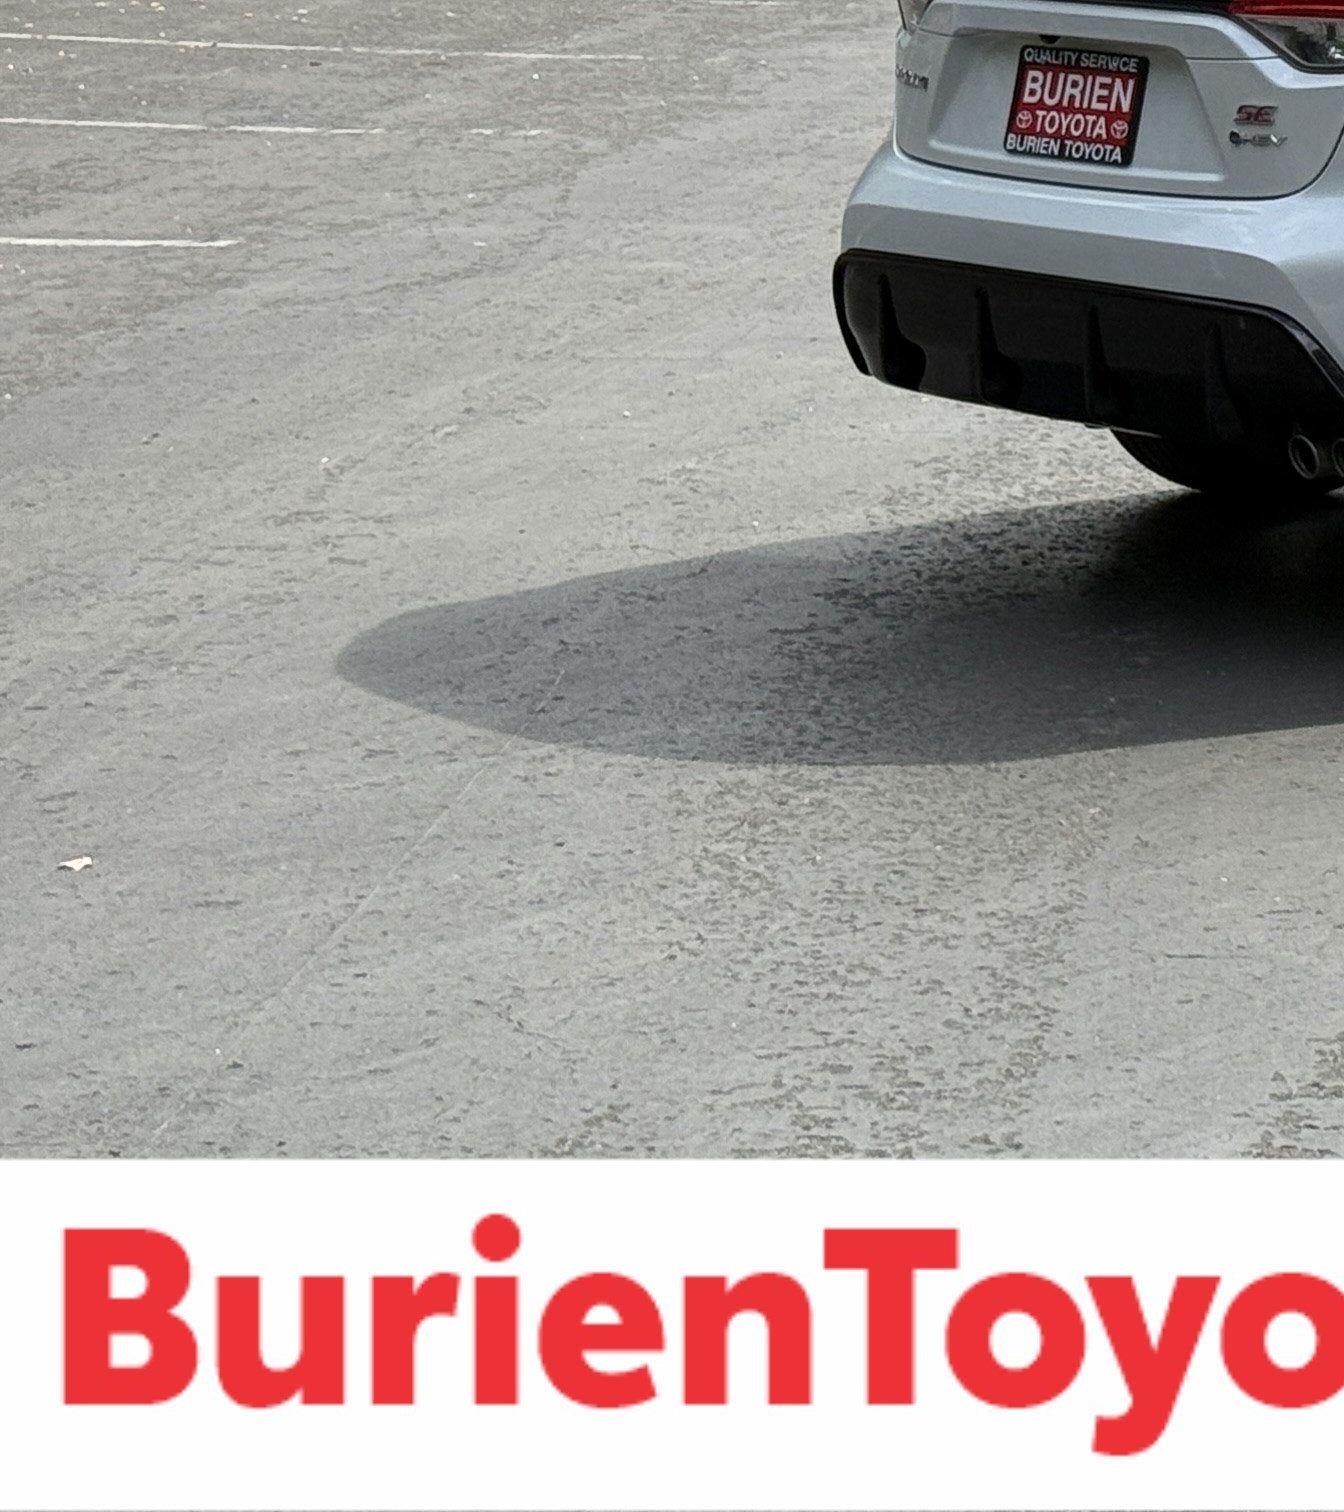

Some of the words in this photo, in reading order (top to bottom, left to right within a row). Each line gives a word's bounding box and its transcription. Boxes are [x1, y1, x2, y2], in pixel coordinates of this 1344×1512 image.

[1023, 47, 1079, 67] QUALITY
[1080, 52, 1140, 73] SERVICE
[1022, 69, 1136, 113] BURIEN
[1035, 109, 1109, 140] TOYOTA
[1005, 133, 1062, 156] BURIEN
[1063, 140, 1123, 164] TOYOTA
